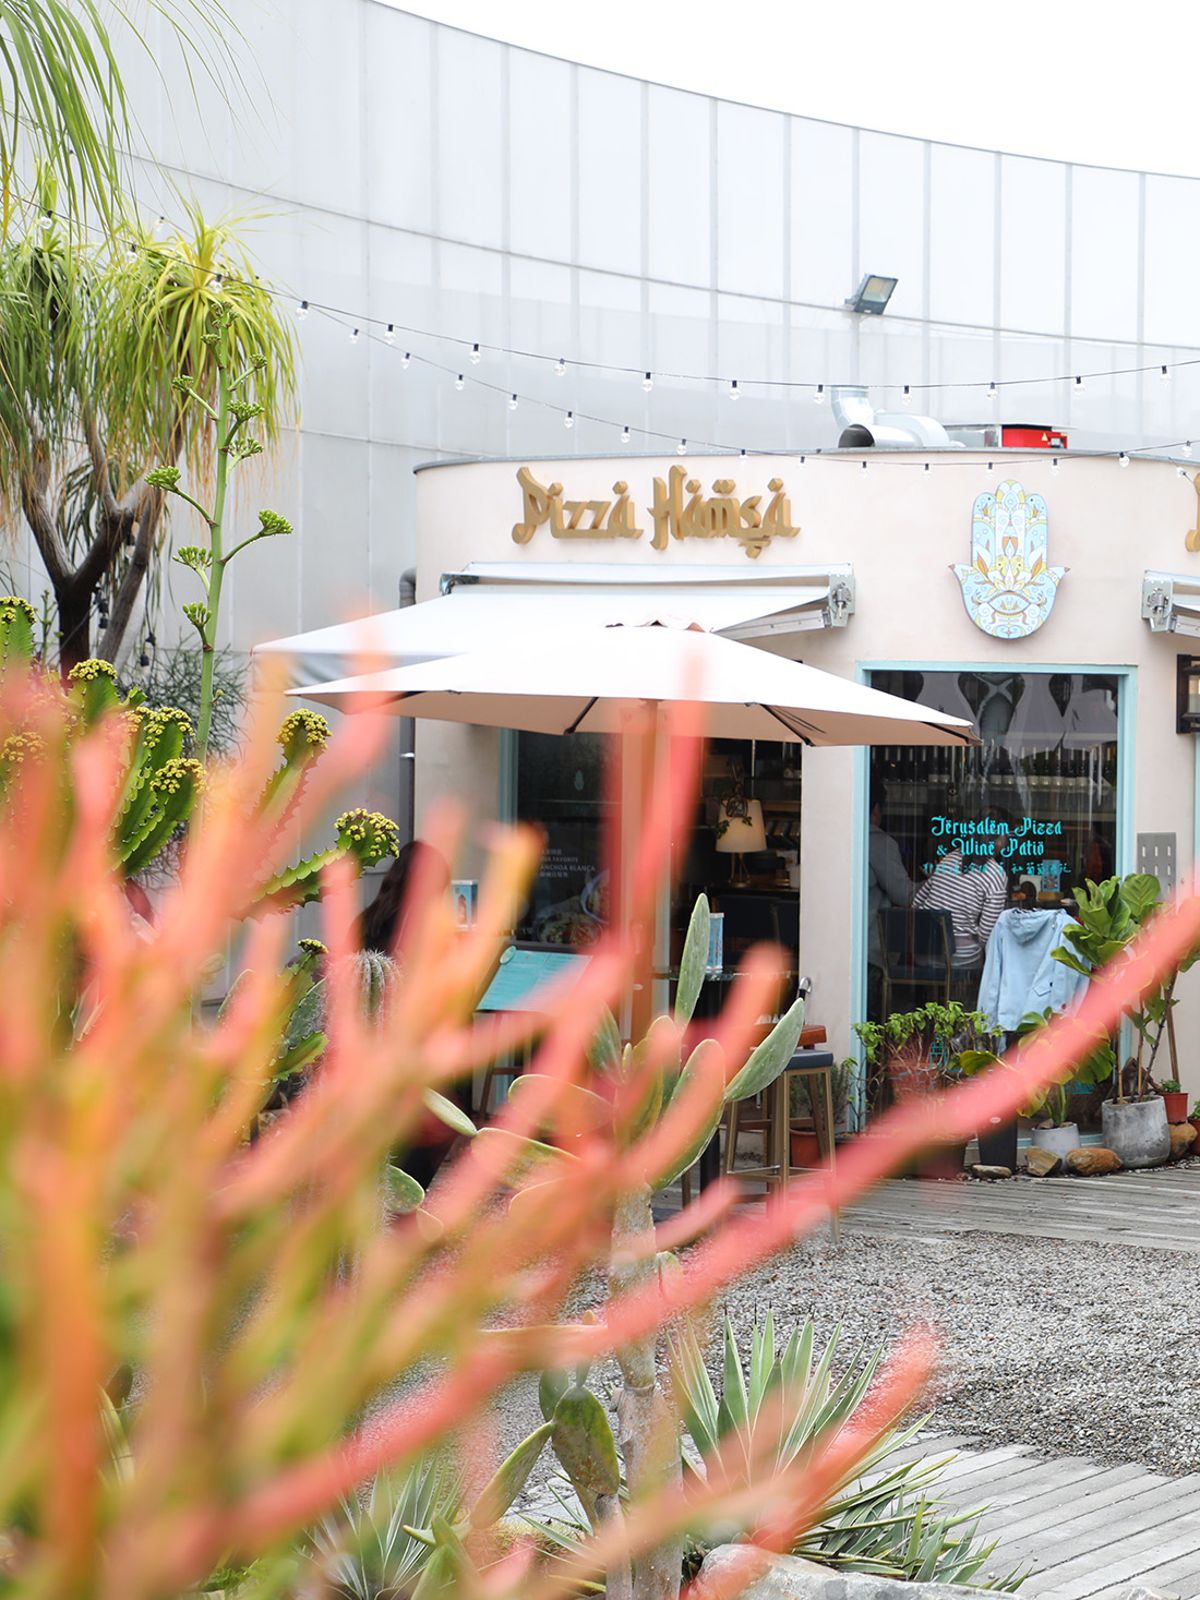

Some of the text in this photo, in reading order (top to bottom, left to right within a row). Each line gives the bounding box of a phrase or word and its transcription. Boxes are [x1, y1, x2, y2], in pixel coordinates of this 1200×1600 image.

[512, 466, 644, 544] Pizza
[1014, 816, 1062, 837] Pizza
[936, 845, 948, 856] &
